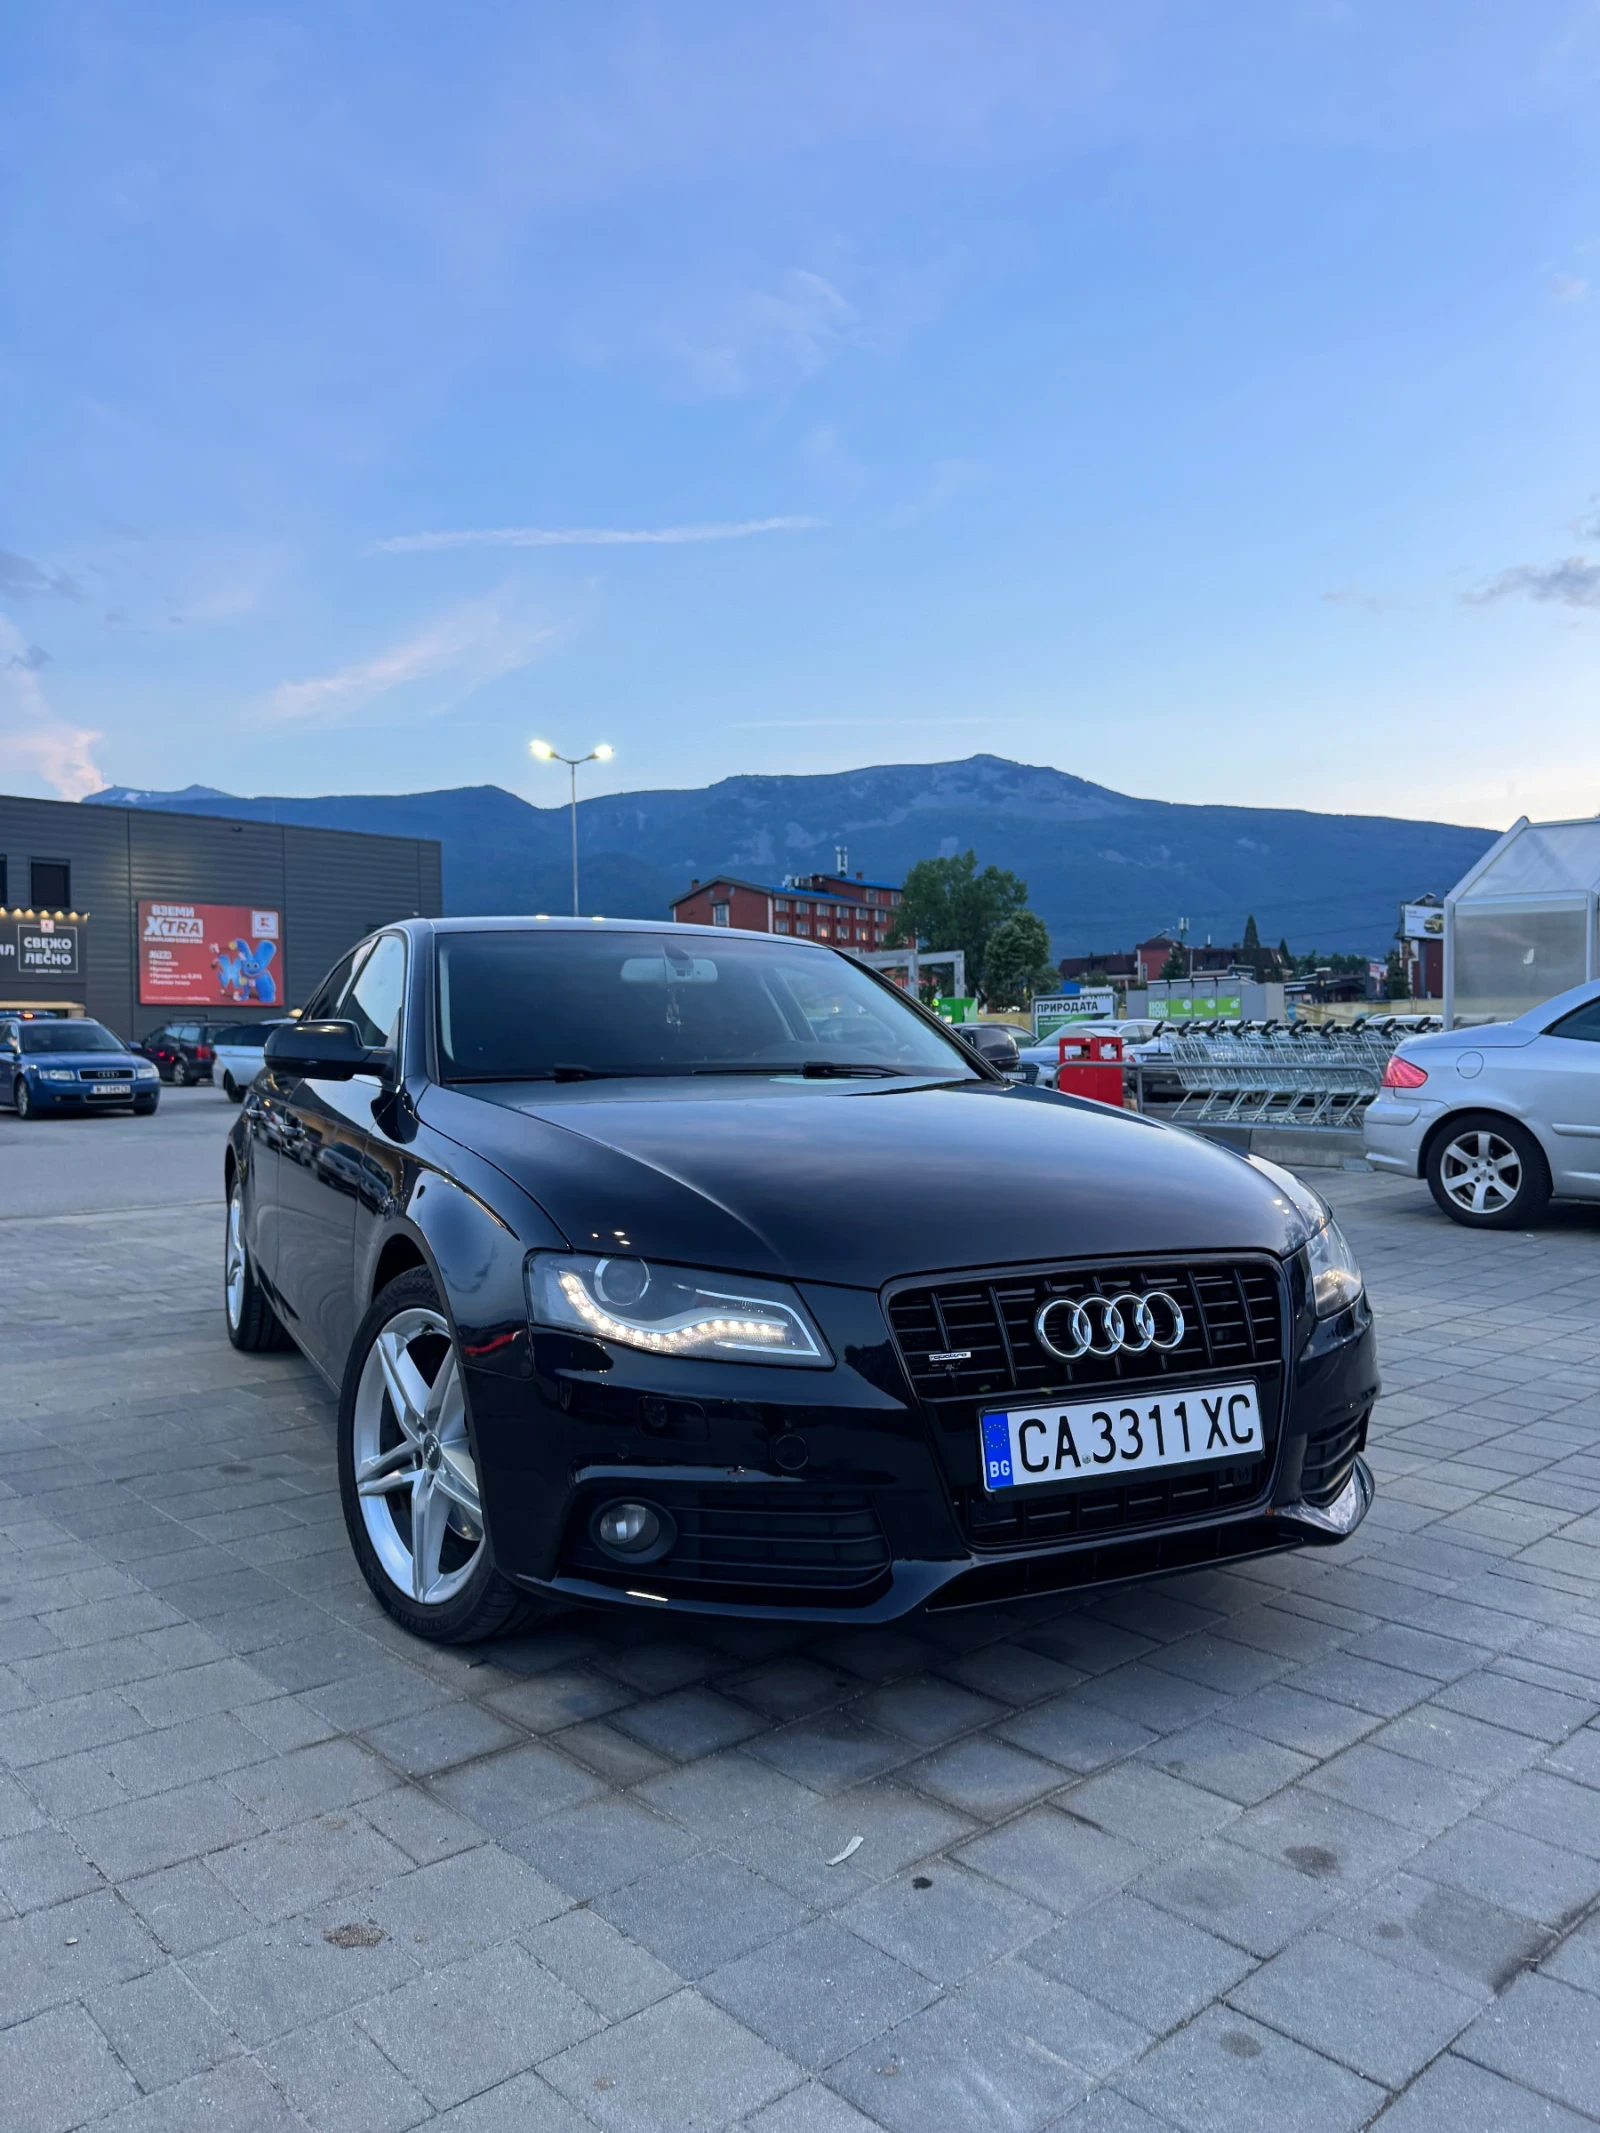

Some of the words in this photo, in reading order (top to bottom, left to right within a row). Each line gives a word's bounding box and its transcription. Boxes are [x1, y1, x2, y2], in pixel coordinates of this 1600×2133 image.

[144, 916, 203, 938] XTRA
[23, 936, 72, 949] СВЕЖО
[25, 952, 72, 965] ЛЕСНО
[1037, 1001, 1098, 1013] ПРИРОДАТА
[989, 1460, 1010, 1478] BG
